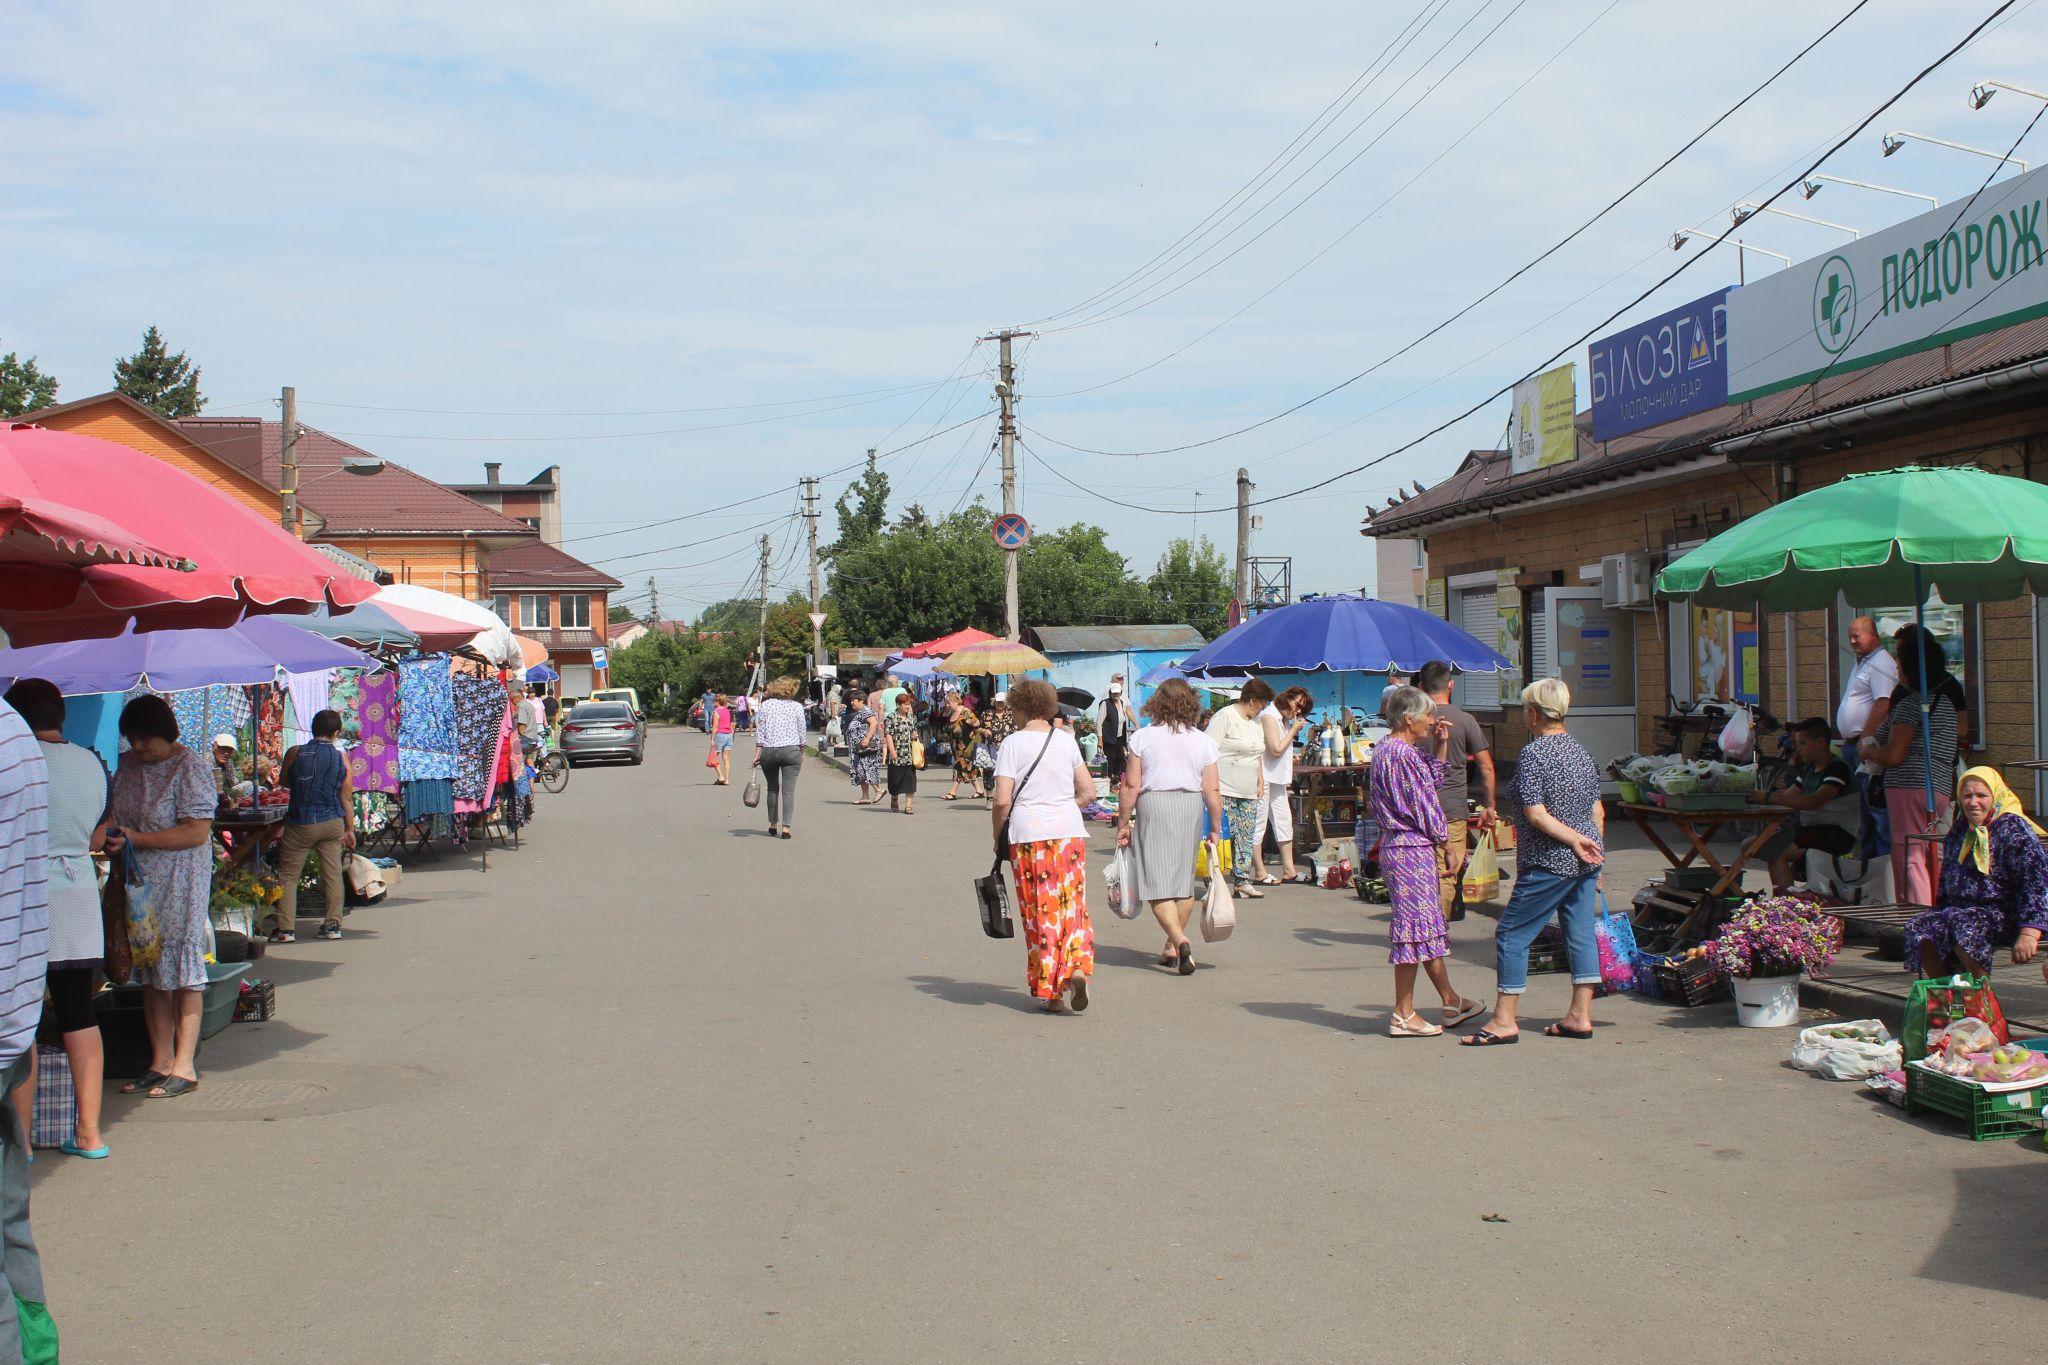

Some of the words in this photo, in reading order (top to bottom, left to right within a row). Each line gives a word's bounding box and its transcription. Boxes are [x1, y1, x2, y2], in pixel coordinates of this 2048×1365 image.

[1882, 196, 2048, 317] ПОДОРОЖ
[1620, 383, 1676, 423] МОЛОЧНИЙ
[1680, 378, 1702, 406] ДАР
